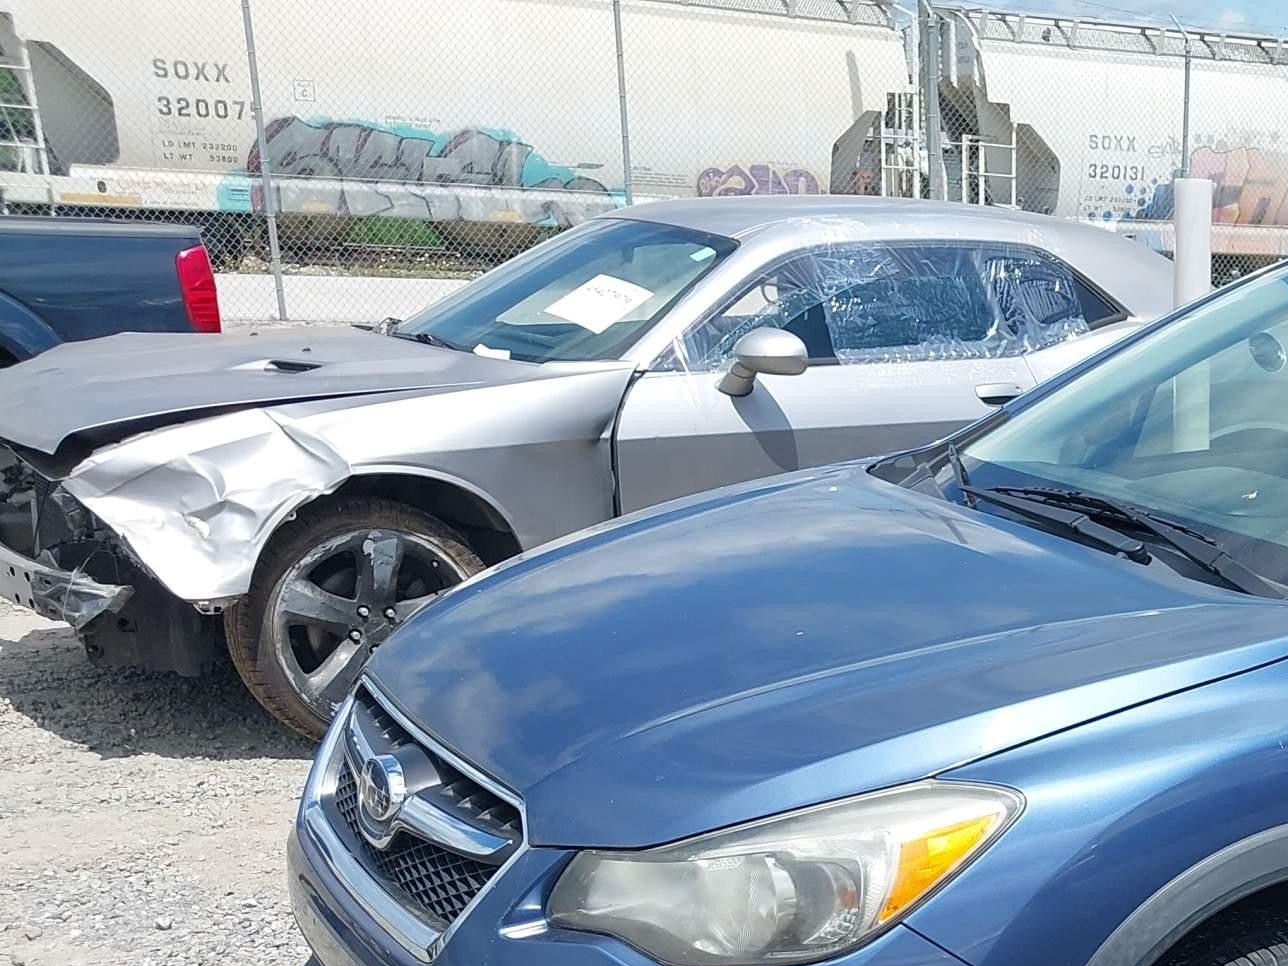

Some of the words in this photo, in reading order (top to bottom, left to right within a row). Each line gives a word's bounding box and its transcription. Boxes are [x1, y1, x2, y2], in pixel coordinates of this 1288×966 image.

[153, 58, 231, 83] SOXX
[1088, 134, 1137, 152] SOXX
[1088, 163, 1145, 181] 320131
